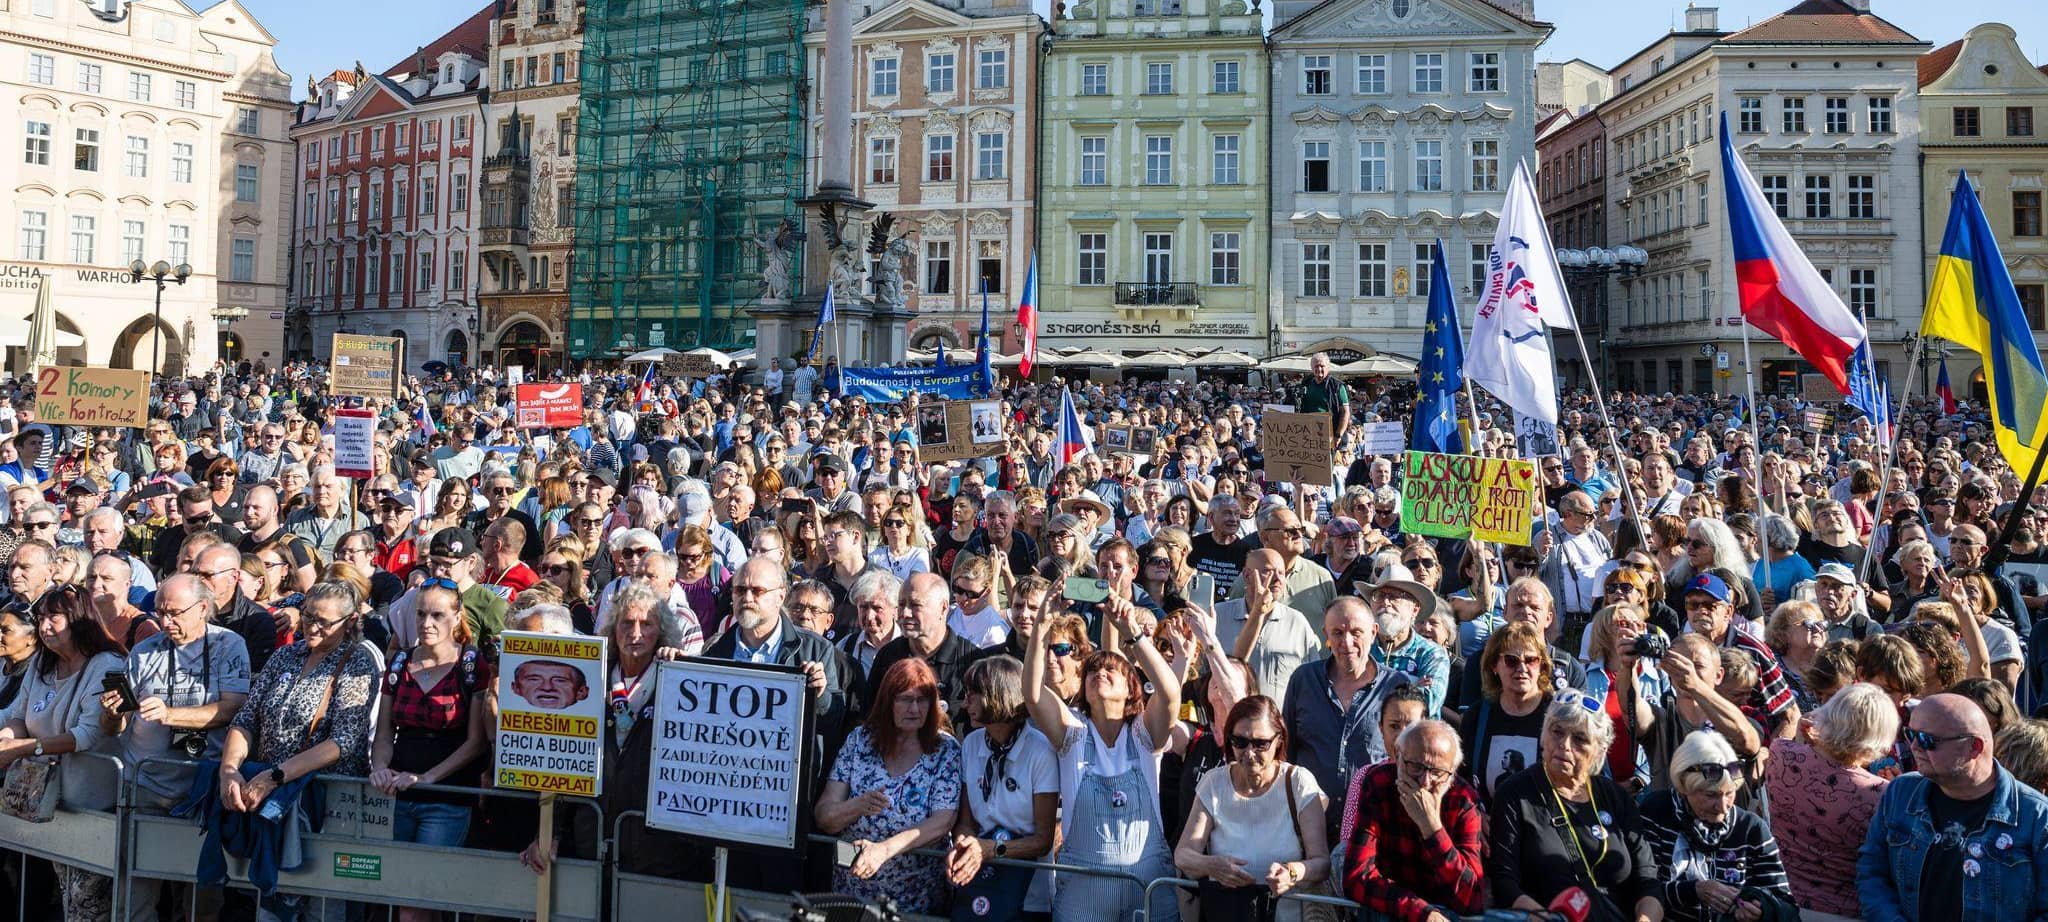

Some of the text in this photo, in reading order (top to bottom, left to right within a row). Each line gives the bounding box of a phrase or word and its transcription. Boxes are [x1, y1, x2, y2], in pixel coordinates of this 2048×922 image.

[0, 279, 38, 289] ibitio
[77, 270, 130, 284] WARHO
[1478, 272, 1504, 319] CHVILEK
[1046, 320, 1161, 334] STAROMĚSTSKÁ
[40, 368, 134, 400] 2 Komory
[845, 376, 909, 387] Budoucnost
[911, 376, 921, 388] je
[924, 375, 961, 387] Evropa
[962, 374, 970, 382] a
[1494, 460, 1512, 487] A
[1406, 480, 1526, 508] ODVAHOU PROTI
[1414, 500, 1521, 532] OLIGARCHII
[504, 639, 599, 658] NEZAJÍMÁ MĚ TO
[677, 678, 788, 720] STOP
[502, 711, 597, 735] NEŘEŠÍM TO
[663, 719, 790, 751] BUREŠOVĚ
[501, 734, 596, 755] CHCI A BUDU!!
[500, 749, 595, 773] ČERPAT DOTACE
[660, 748, 791, 773] ZADLUŽOVACÍMU
[541, 775, 594, 793] ZAPLATÍ
[659, 767, 790, 792] RUDOHNĚDÉMU
[657, 791, 788, 822] PANOPTIKU!!!
